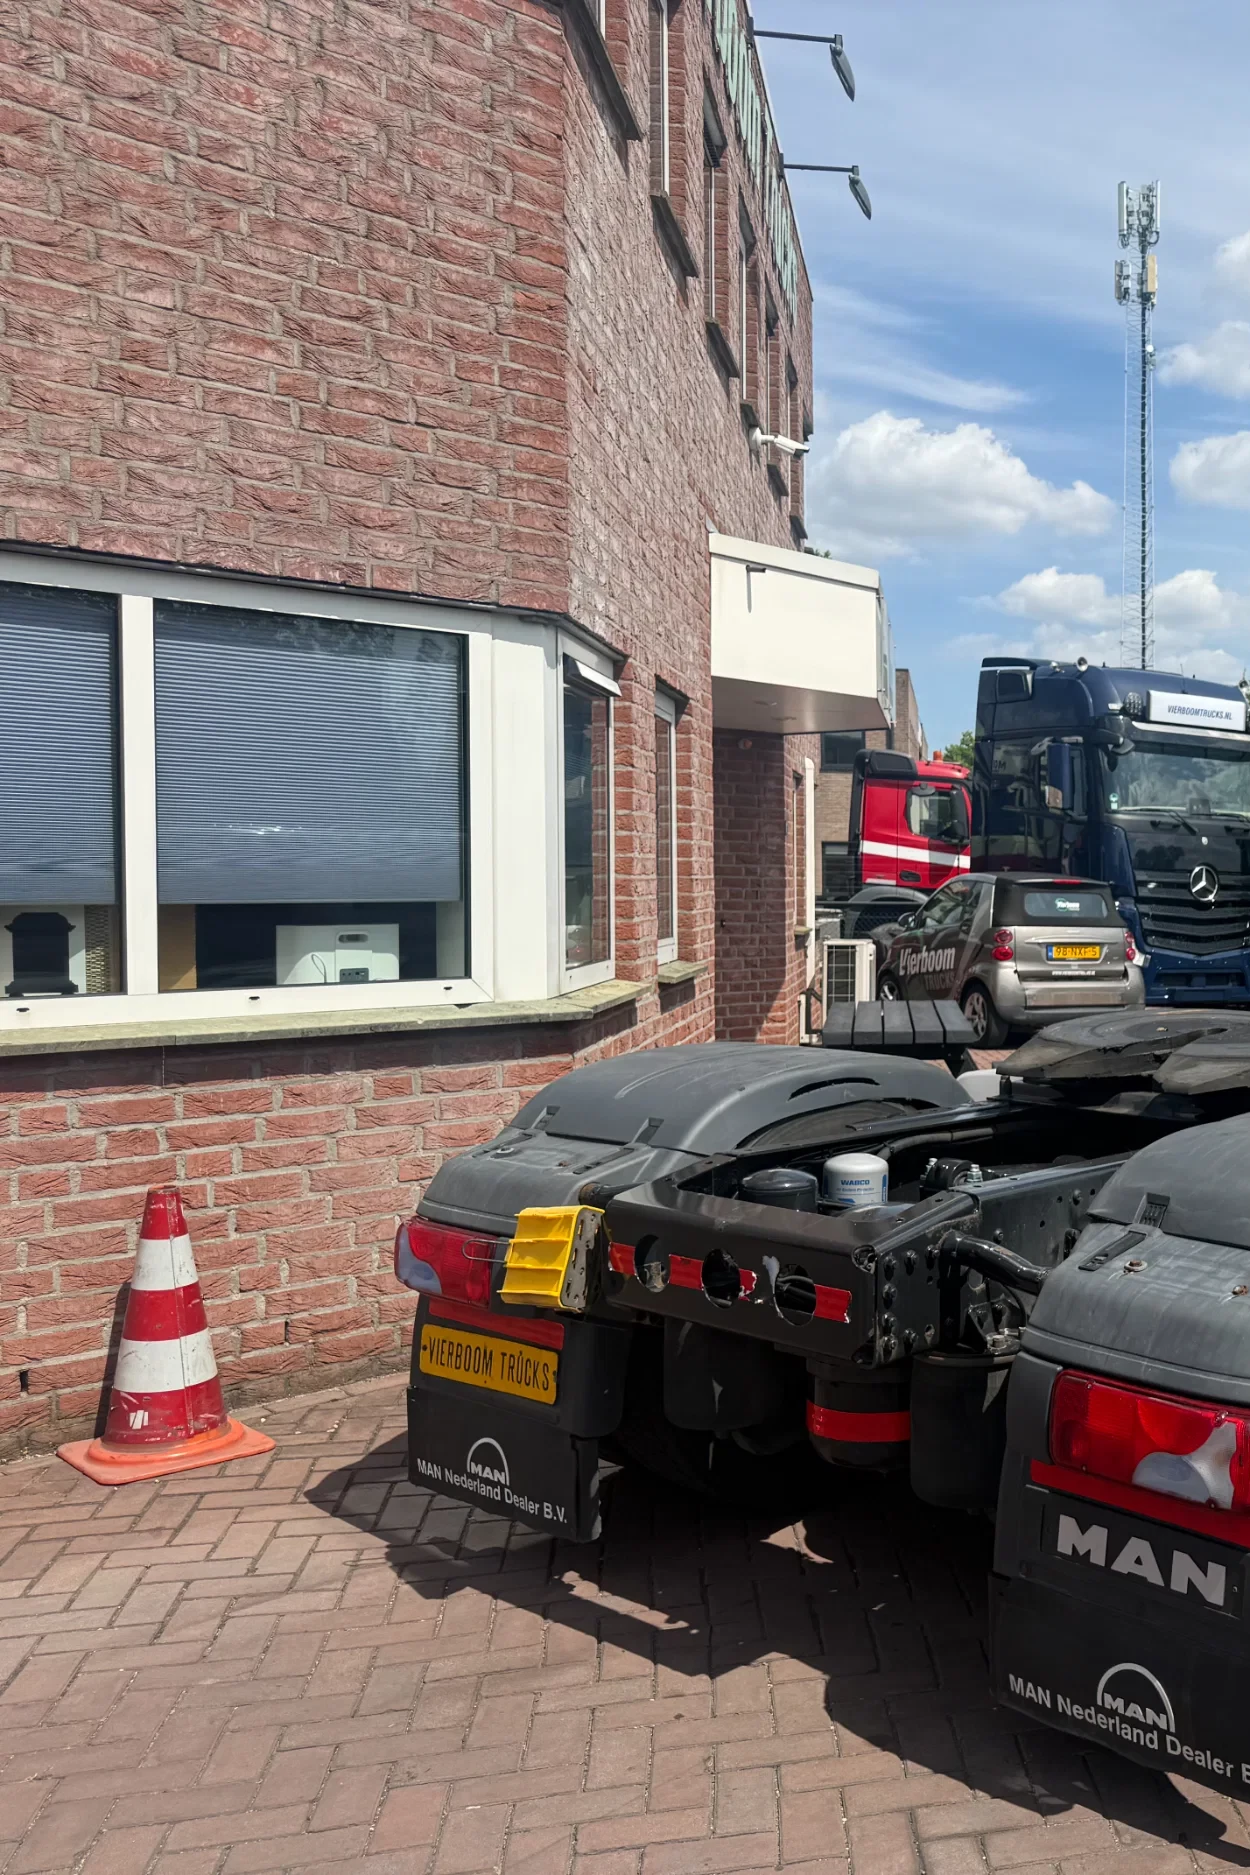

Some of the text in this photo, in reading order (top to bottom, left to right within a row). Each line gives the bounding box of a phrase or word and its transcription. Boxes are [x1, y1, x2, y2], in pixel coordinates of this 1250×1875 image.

[1167, 704, 1232, 720] VIERBOOMTRUCKS.NL
[899, 945, 956, 976] Vierboom
[923, 970, 956, 991] TRUCKS
[428, 1336, 549, 1391] VIERBOOM TRUCKS
[417, 1458, 568, 1524] MAN Nederland Dealer B.V.
[470, 1461, 506, 1484] MAN
[1057, 1514, 1227, 1607] MAN
[1008, 1673, 1051, 1709] MAN
[1057, 1694, 1158, 1750] Nederland
[1165, 1734, 1234, 1779] Dealer
[1102, 1692, 1168, 1730] MAN
